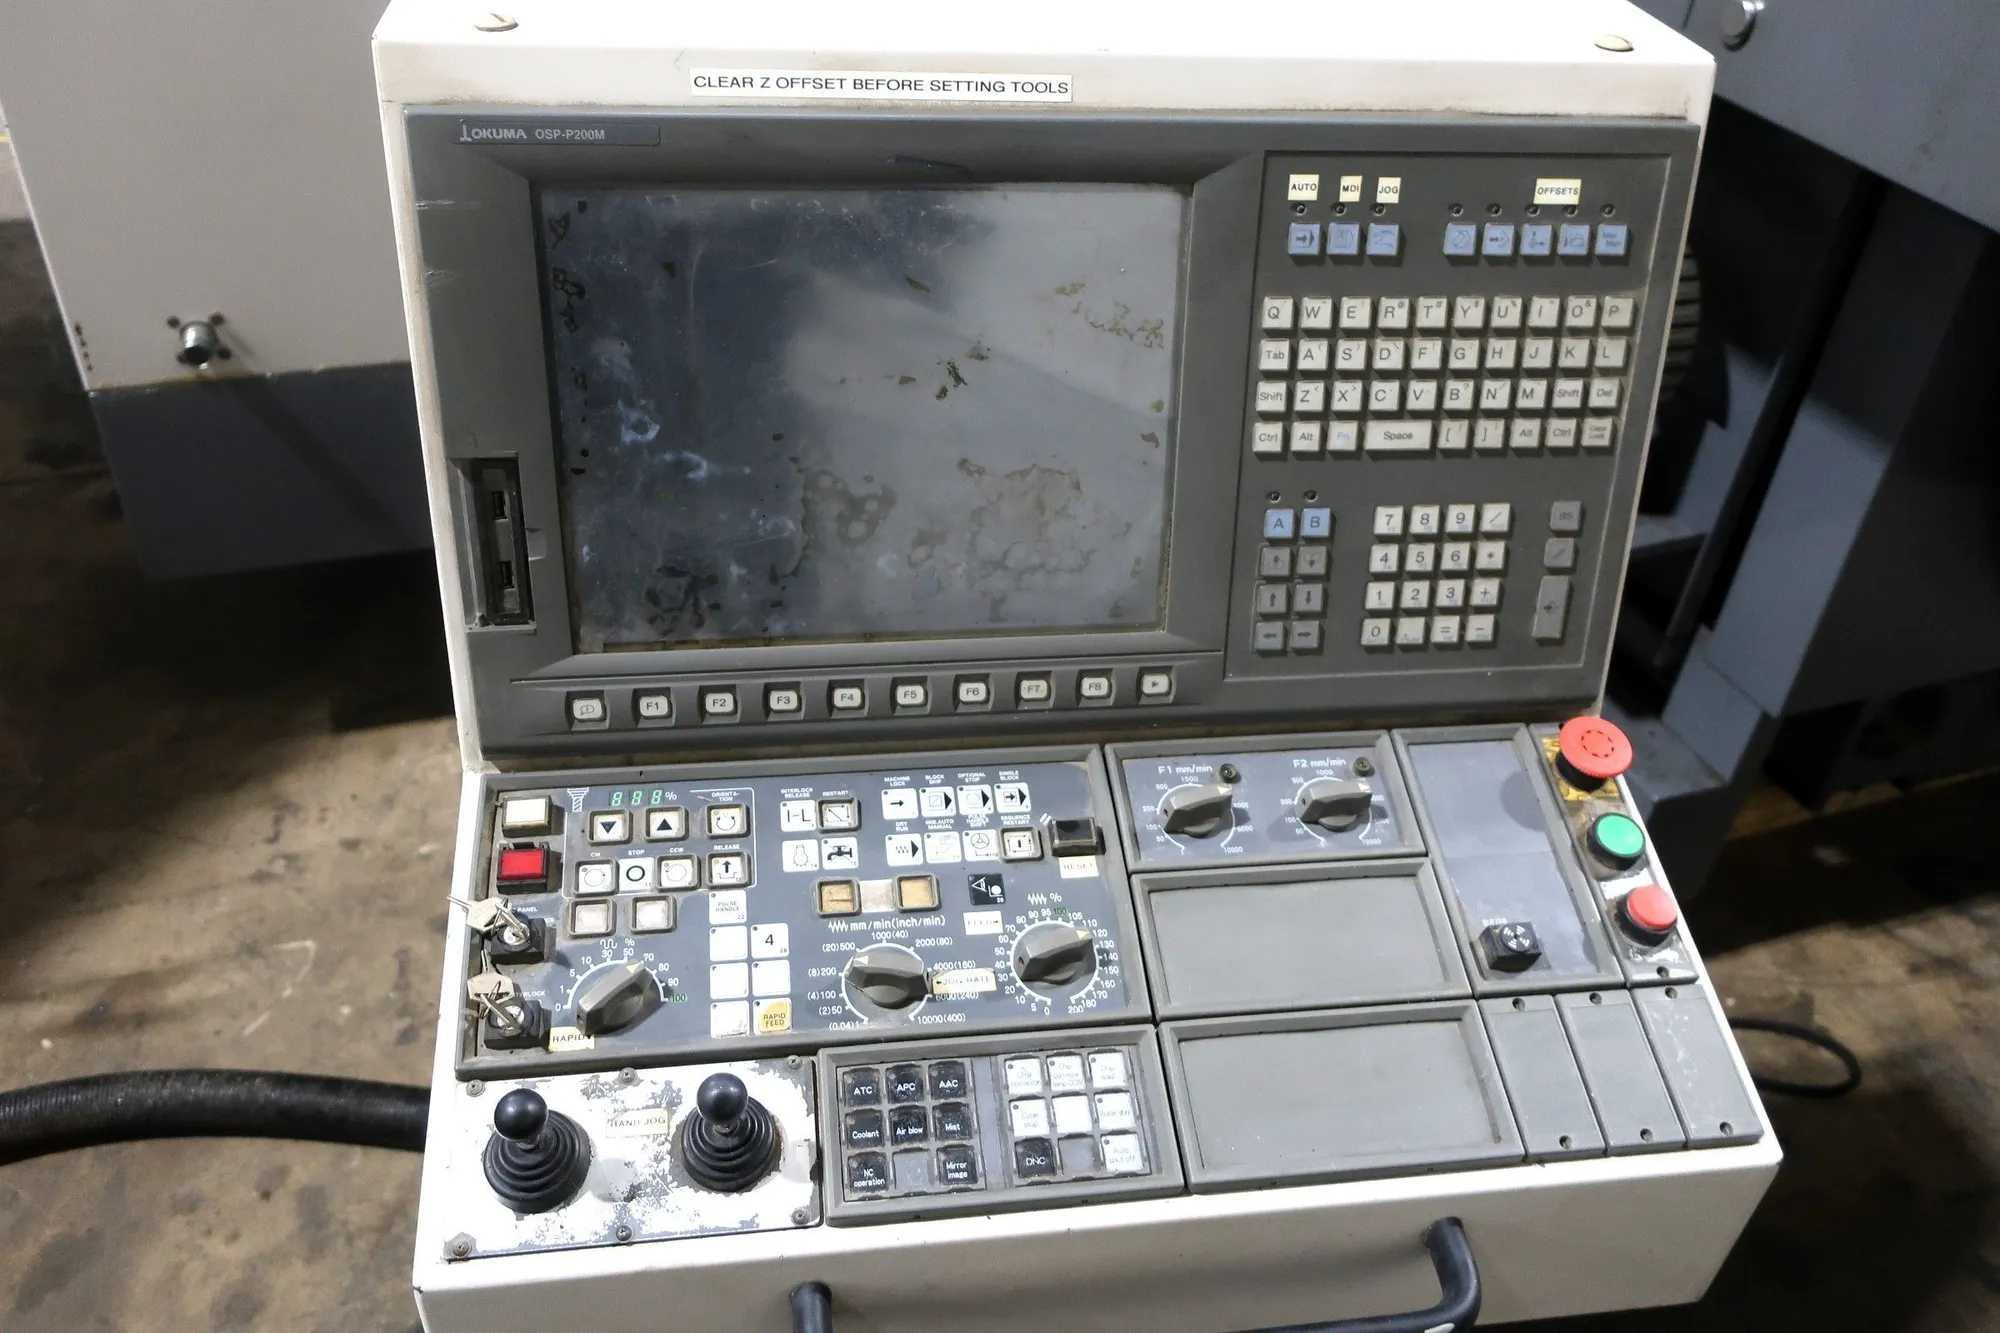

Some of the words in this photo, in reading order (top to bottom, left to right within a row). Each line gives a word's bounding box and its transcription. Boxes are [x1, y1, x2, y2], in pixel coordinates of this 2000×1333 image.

[694, 76, 754, 88] CLEAR
[760, 77, 771, 89] Z
[776, 77, 847, 90] OFFSET
[853, 79, 924, 91] BEFORE
[930, 80, 1005, 92] SETTING
[1011, 81, 1068, 94] TOOLS
[471, 128, 527, 140] OKUMA
[535, 128, 605, 140] OSP-P200M
[1291, 183, 1317, 191] AUTO
[1342, 185, 1360, 193] MDI
[1379, 185, 1399, 194] JOG
[1536, 187, 1579, 196] OFFSETS
[1267, 306, 1280, 319] Q
[1305, 306, 1321, 319] W
[1347, 306, 1357, 319] E
[1384, 306, 1395, 318] R
[1424, 306, 1433, 318] T
[1460, 306, 1471, 318] Y
[1497, 306, 1509, 318] U
[1538, 306, 1543, 317] I
[1572, 305, 1583, 318] O
[1609, 305, 1620, 317] P
[1265, 350, 1285, 360] Tab
[1303, 348, 1314, 360] A
[1342, 348, 1352, 360] S
[1379, 348, 1391, 360] D
[1418, 347, 1428, 359] F
[1454, 348, 1466, 360] G
[1491, 347, 1503, 359] H
[1529, 347, 1539, 359] J
[1565, 347, 1576, 358] K
[1602, 347, 1610, 358] L
[1258, 392, 1283, 401] Shift
[1300, 391, 1310, 402] Z
[1338, 390, 1348, 402] X
[1375, 389, 1387, 401] C
[1413, 389, 1423, 401] V
[1450, 388, 1460, 400] B
[1486, 388, 1497, 400] N
[1522, 388, 1534, 399] M
[1557, 388, 1579, 398] Shift
[1258, 432, 1278, 442] Ctrl
[1299, 432, 1313, 441] Alt
[1383, 431, 1413, 440] Space
[1552, 428, 1571, 437] Ctrl
[1274, 518, 1284, 528] A
[1310, 516, 1320, 528] B
[1385, 514, 1393, 526] 7
[1420, 513, 1430, 525] 8
[1456, 512, 1465, 524] 9
[1379, 552, 1388, 564] 4
[1416, 552, 1425, 563] 5
[1451, 551, 1460, 562] 6
[1376, 590, 1381, 600] 1
[1411, 588, 1419, 600] 2
[1446, 588, 1455, 599] 3
[1371, 626, 1380, 637] 0
[966, 687, 980, 696] F6
[1027, 685, 1040, 694] F7
[1088, 682, 1102, 691] F8
[840, 693, 854, 702] F4
[903, 690, 917, 699] F5
[712, 698, 727, 708] F2
[776, 696, 791, 705] F3
[646, 702, 659, 712] F1
[1082, 919, 1097, 927] 110
[765, 934, 774, 946] 4
[601, 950, 613, 958] 30
[643, 953, 654, 962] 70
[581, 956, 592, 964] 10
[995, 961, 1005, 969] 40
[569, 969, 575, 977] 5
[998, 973, 1008, 981] 30
[559, 986, 564, 994] 1
[1005, 986, 1015, 994] 20
[808, 991, 836, 1000] (4)100
[1015, 996, 1025, 1004] 10
[555, 1004, 561, 1012] 0
[1031, 1003, 1036, 1012] 5
[1044, 1007, 1049, 1015] 0
[1068, 1005, 1083, 1014] 200
[765, 1020, 785, 1028] FEED
[896, 1083, 916, 1092] APC
[939, 1080, 958, 1088] AAC
[854, 1086, 873, 1095] ATC
[644, 1116, 666, 1125] JOG
[896, 1127, 907, 1135] Air
[908, 1126, 923, 1134] blow
[945, 1123, 960, 1131] Mist
[852, 1131, 879, 1139] Coolant
[946, 1161, 967, 1170] Mirror
[1026, 1156, 1046, 1166] DNC
[863, 1169, 874, 1177] NC
[948, 1169, 967, 1179] image
[854, 1177, 885, 1187] operation
